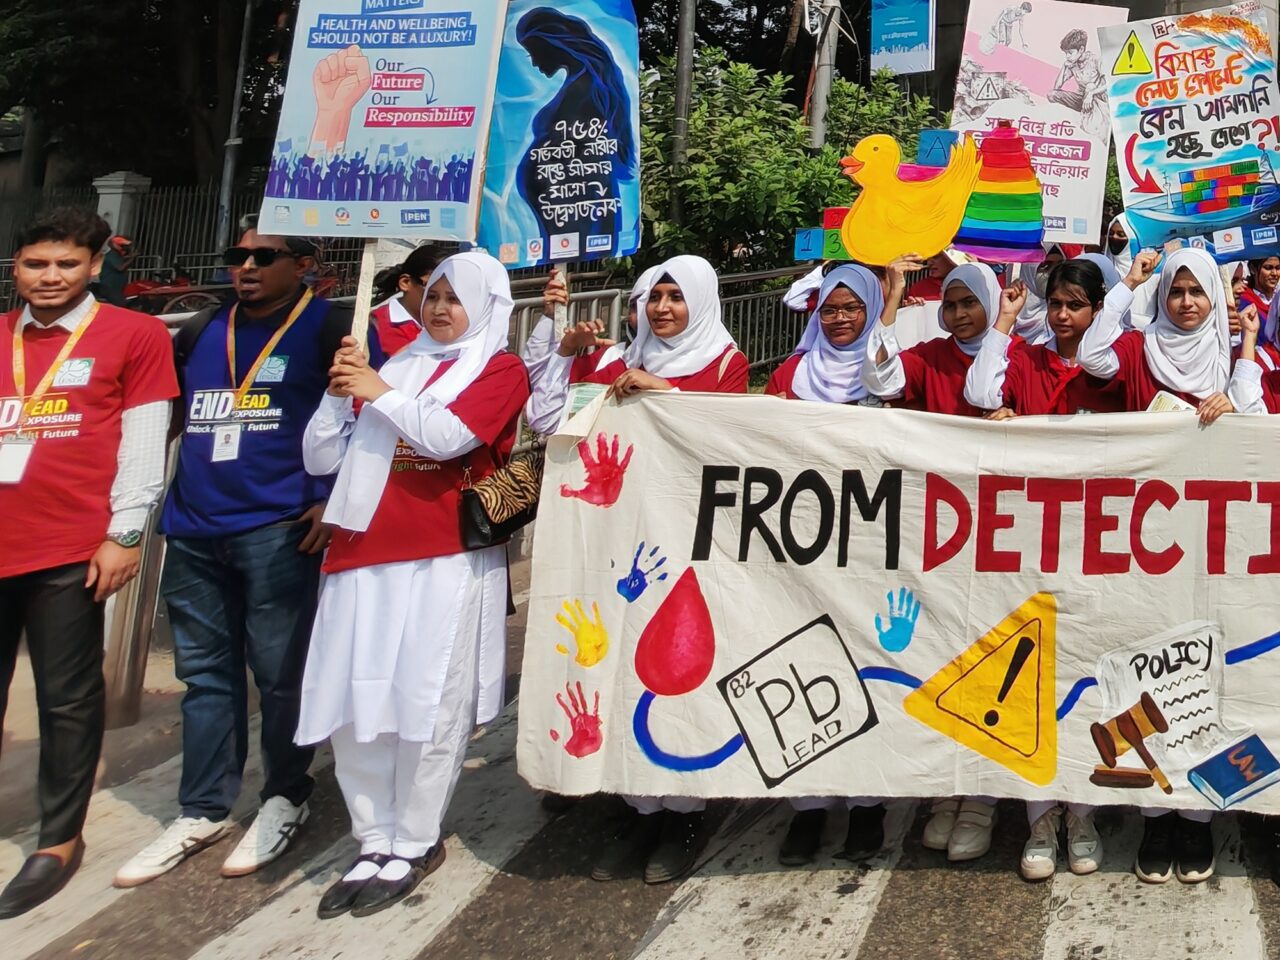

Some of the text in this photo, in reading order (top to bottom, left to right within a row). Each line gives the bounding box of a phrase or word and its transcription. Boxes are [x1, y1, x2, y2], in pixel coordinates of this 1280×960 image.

[320, 16, 467, 30] HEALTH AND WELLBEING
[311, 30, 472, 44] SHOULD NOT BE A LUXURY!
[375, 58, 404, 72] Our
[373, 74, 423, 89] Future
[371, 93, 400, 106] Our
[367, 108, 475, 126] Responsibility
[1139, 104, 1187, 139] কেন
[925, 136, 947, 160] A
[801, 231, 813, 251] 1
[828, 232, 841, 254] 3
[190, 392, 234, 419] END
[27, 414, 83, 425] XPOSURE
[248, 423, 279, 431] Future
[43, 430, 79, 438] Future
[396, 447, 417, 456] EXPO
[690, 465, 902, 570] FROM
[1129, 633, 1213, 682] POLICY
[729, 670, 756, 699] 82
[756, 663, 840, 751] Pb
[782, 720, 843, 769] LEAD
[1228, 744, 1264, 782] LAW
